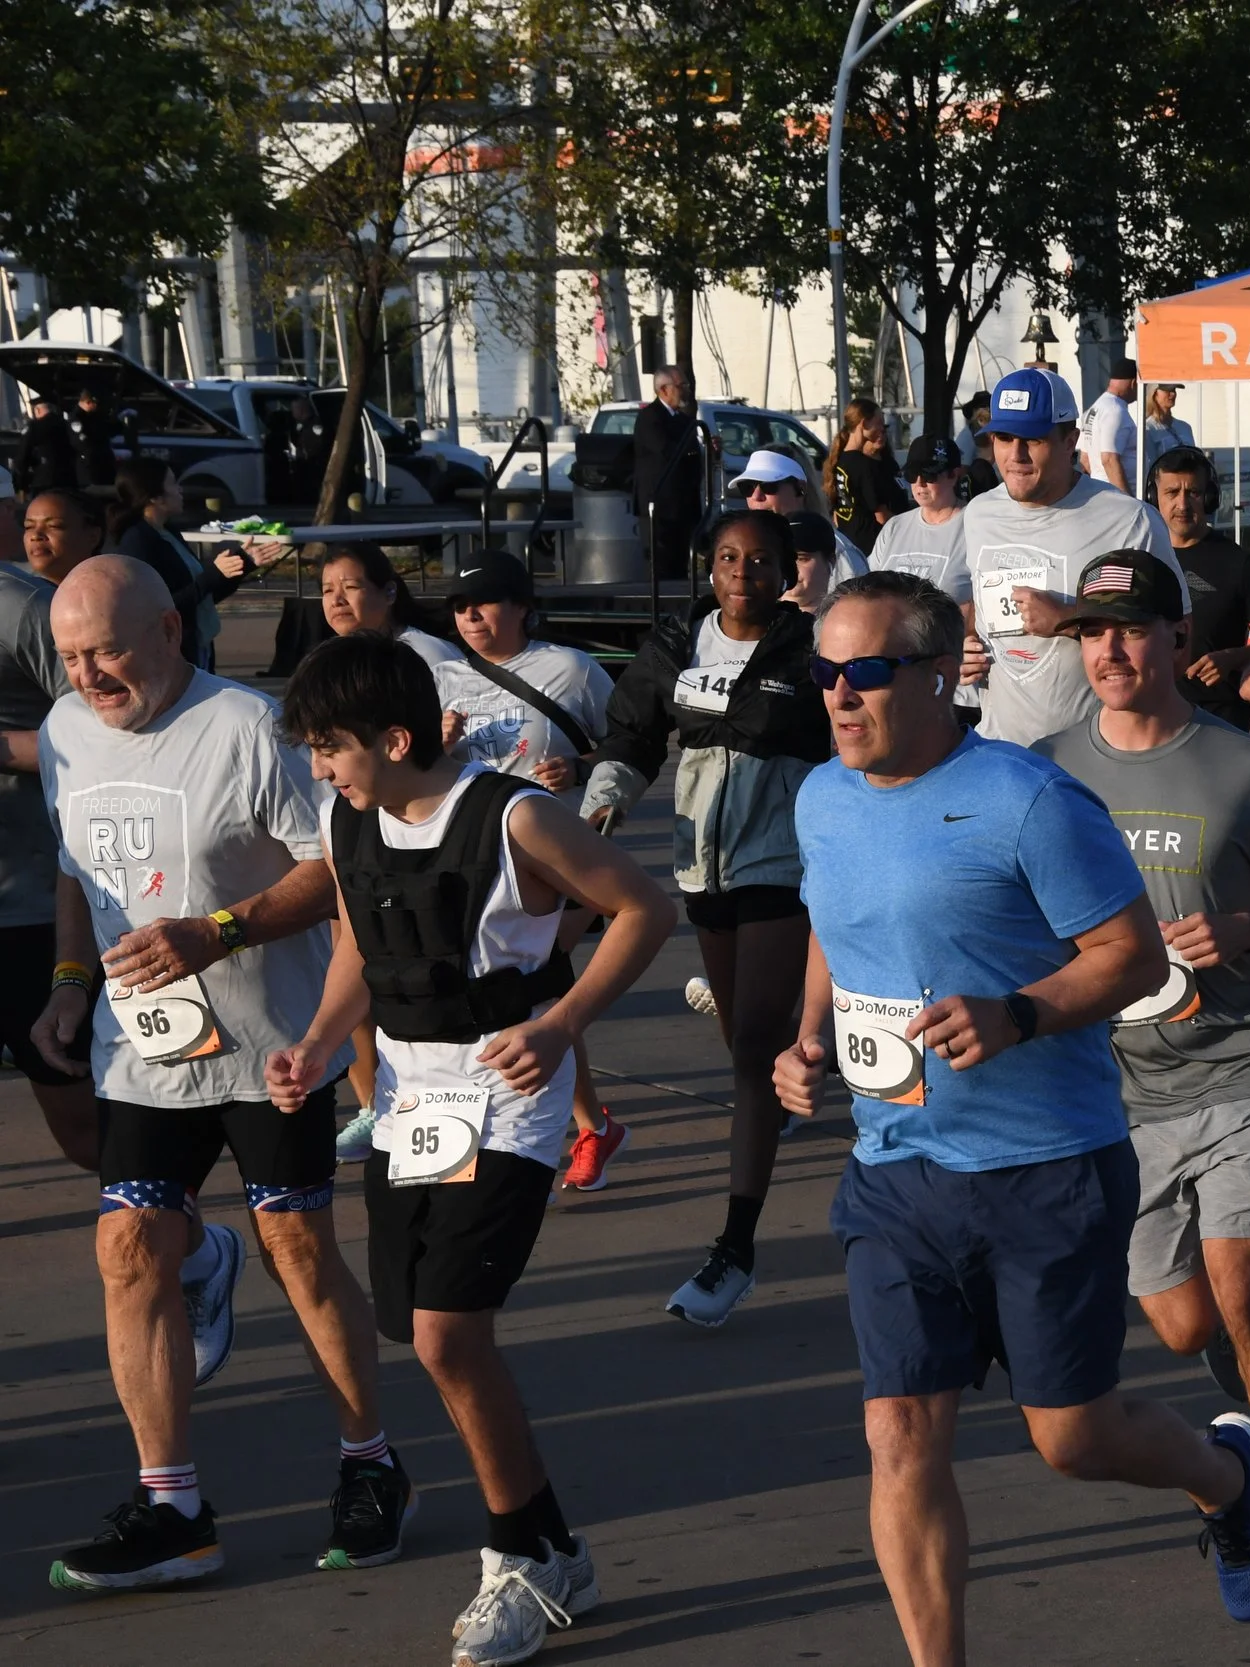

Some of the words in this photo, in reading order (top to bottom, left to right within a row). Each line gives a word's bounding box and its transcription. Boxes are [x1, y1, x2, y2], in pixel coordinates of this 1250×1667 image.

[81, 796, 162, 815] FREEDOM
[87, 818, 155, 864] RU
[1125, 830, 1182, 853] YER
[94, 867, 129, 910] N
[136, 1008, 171, 1038] 96
[848, 1033, 877, 1067] 89
[411, 1126, 440, 1156] 95
